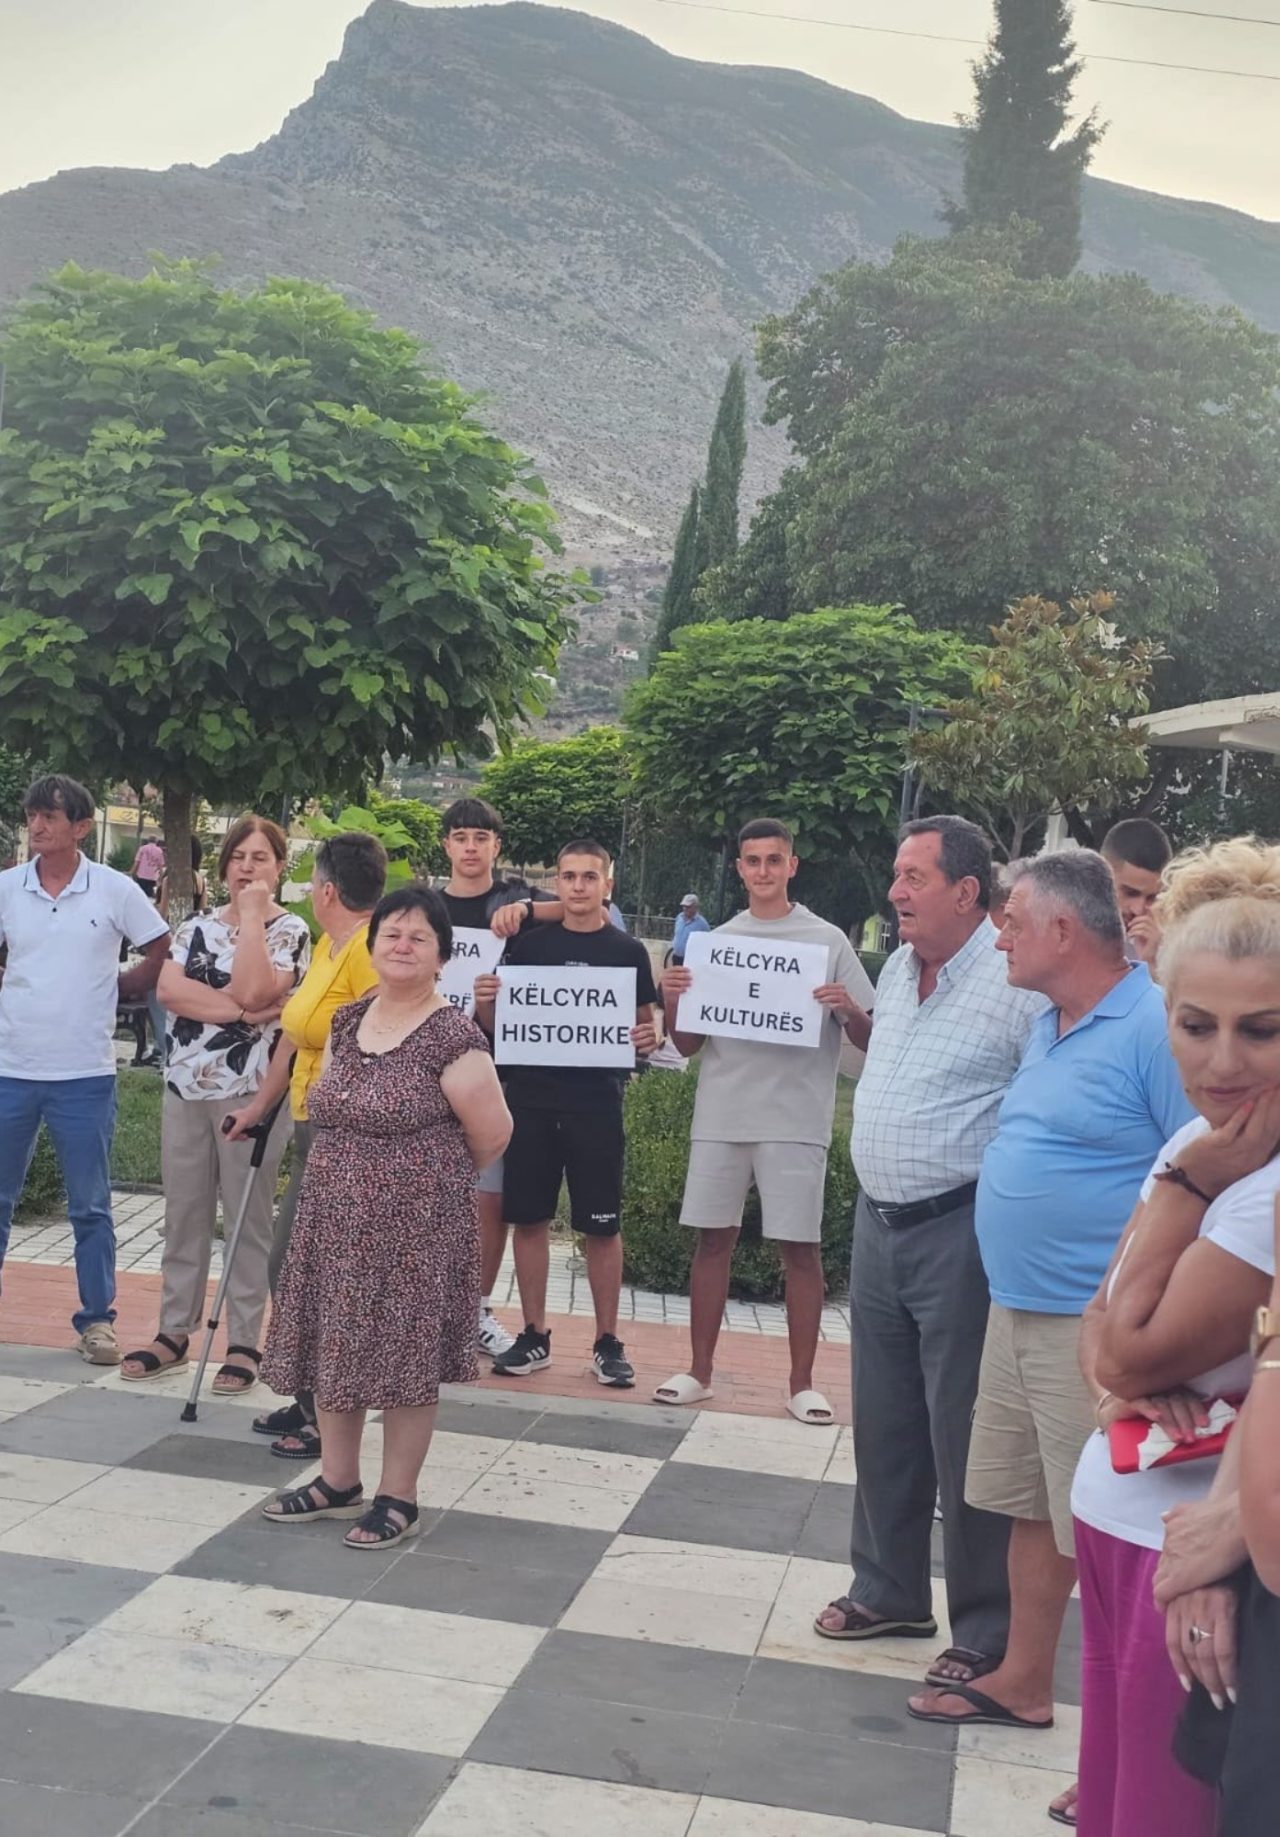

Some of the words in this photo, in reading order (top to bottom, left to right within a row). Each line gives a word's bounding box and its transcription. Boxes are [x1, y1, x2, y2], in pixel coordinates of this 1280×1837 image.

[710, 946, 801, 975] KËLCYRA
[509, 982, 618, 1008] KËLCYRA
[749, 982, 761, 999] E
[700, 1004, 804, 1033] KULTURËS
[502, 1023, 630, 1045] HISTORIKE
